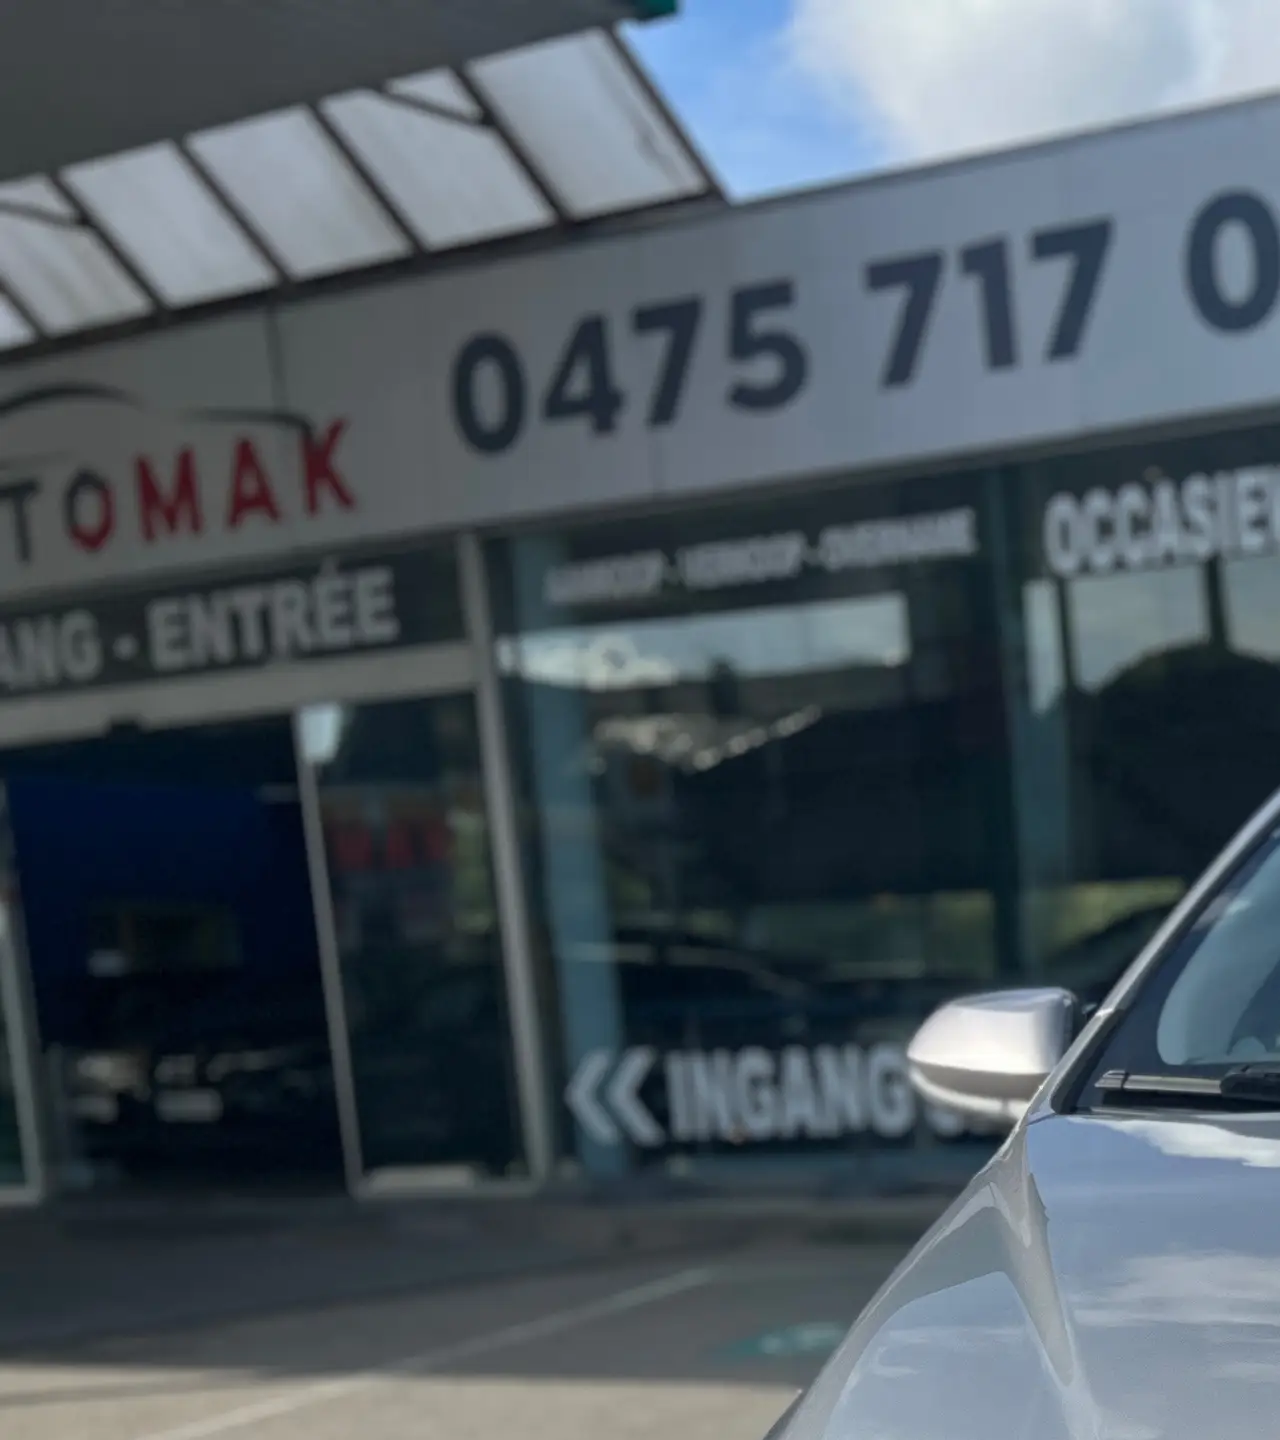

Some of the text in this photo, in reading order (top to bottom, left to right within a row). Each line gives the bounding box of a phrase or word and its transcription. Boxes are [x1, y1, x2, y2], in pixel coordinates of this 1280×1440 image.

[452, 278, 811, 456] 0475
[862, 216, 1114, 390] 717
[148, 556, 398, 671] ENTRÉE
[666, 1043, 917, 1143] INGANG
